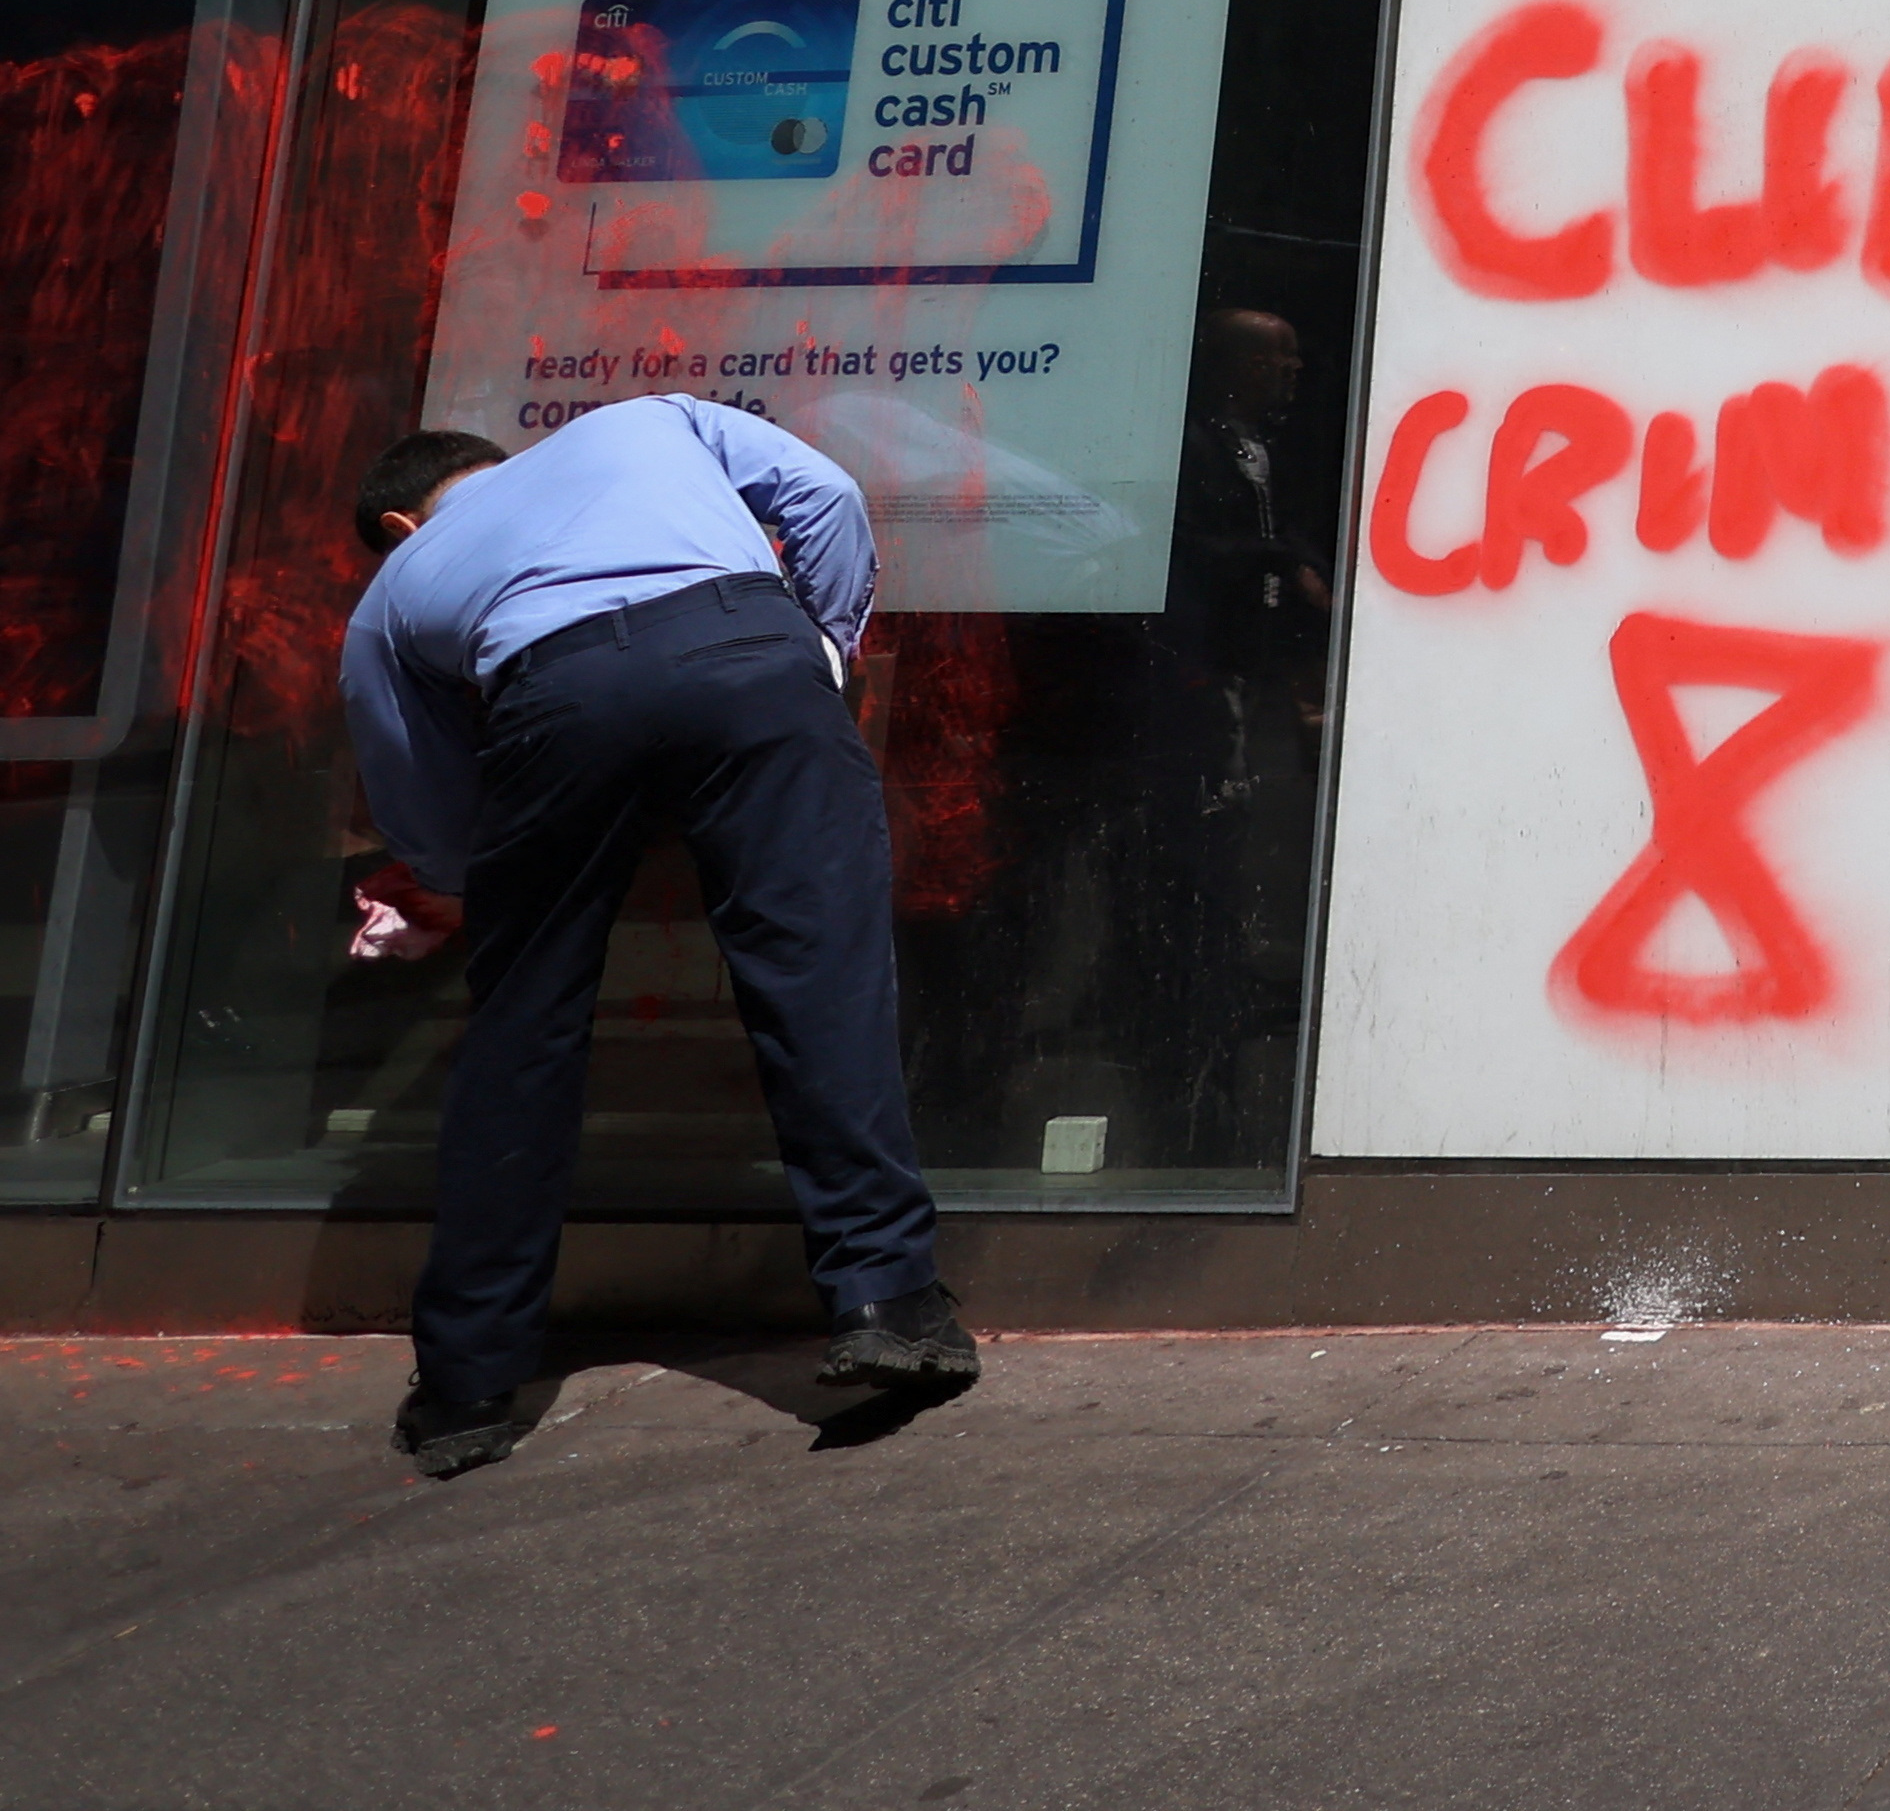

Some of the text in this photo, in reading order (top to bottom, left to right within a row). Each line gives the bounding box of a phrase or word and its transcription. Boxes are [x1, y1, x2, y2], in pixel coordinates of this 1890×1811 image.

[594, 7, 628, 28] citi
[882, 33, 1060, 76] custom
[703, 72, 768, 86] CUSTOM
[764, 82, 807, 97] CASH
[868, 133, 975, 177] card
[525, 343, 1060, 385] ready for a card that gets you?
